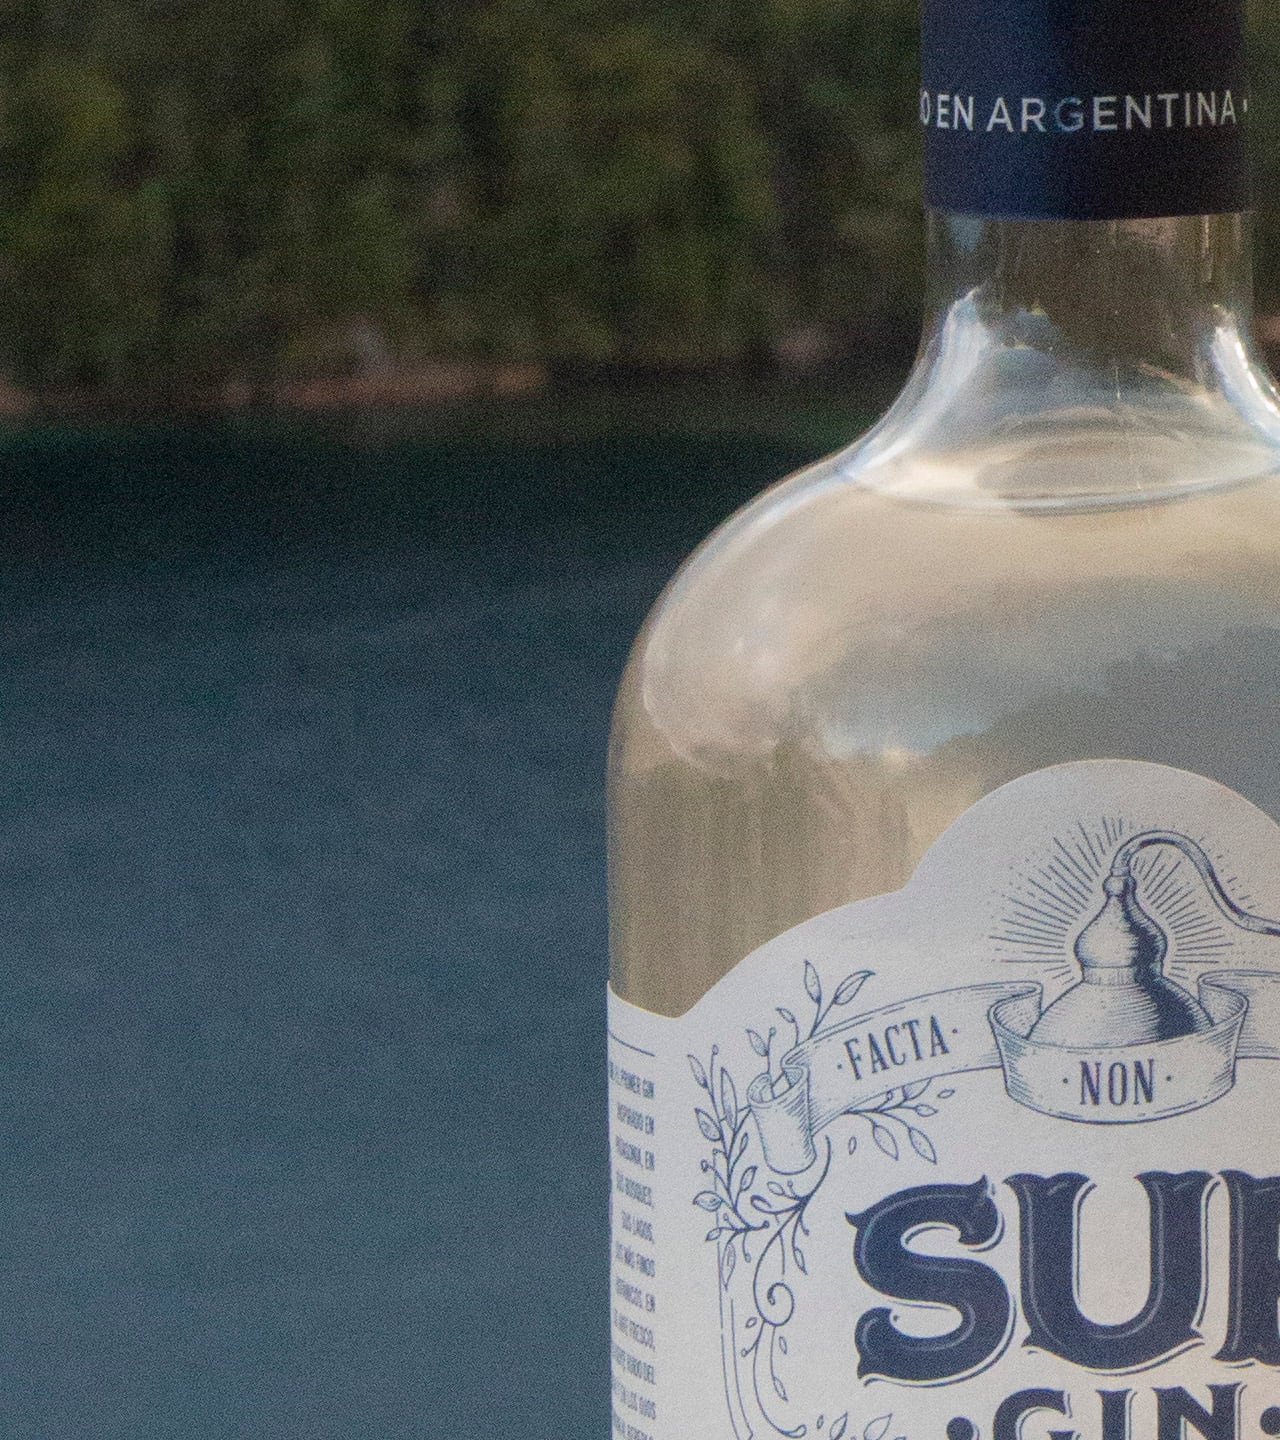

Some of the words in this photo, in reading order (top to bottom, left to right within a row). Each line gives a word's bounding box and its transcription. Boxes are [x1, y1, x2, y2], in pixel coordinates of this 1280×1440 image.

[936, 93, 974, 131] EN
[985, 89, 1238, 133] ARGENTINA
[844, 1014, 949, 1081] FACTA
[1079, 1058, 1155, 1107] NON
